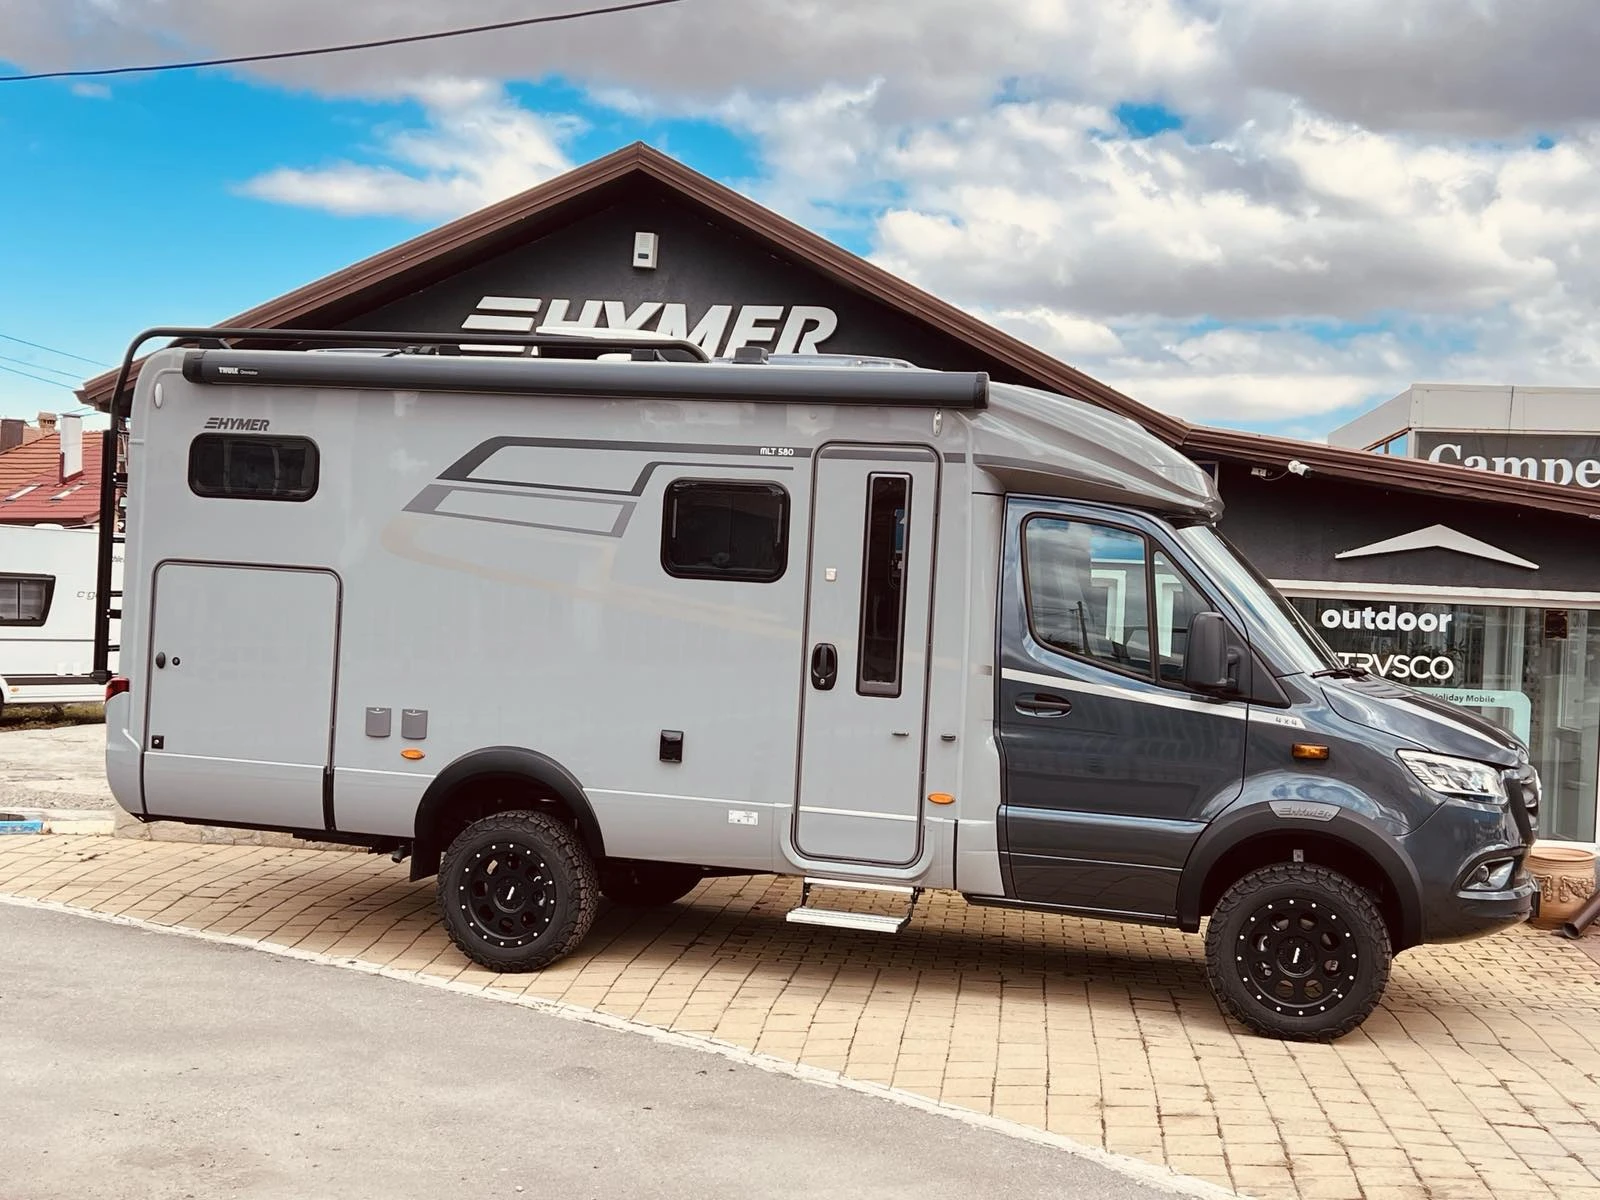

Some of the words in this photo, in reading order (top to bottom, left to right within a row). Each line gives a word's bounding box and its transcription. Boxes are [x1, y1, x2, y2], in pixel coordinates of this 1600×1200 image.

[217, 417, 270, 432] HYMER
[760, 447, 777, 456] MLT
[777, 447, 795, 456] 580
[1321, 605, 1452, 632] outdoor
[1334, 652, 1454, 680] TRVSCO
[1466, 694, 1496, 704] Mobile
